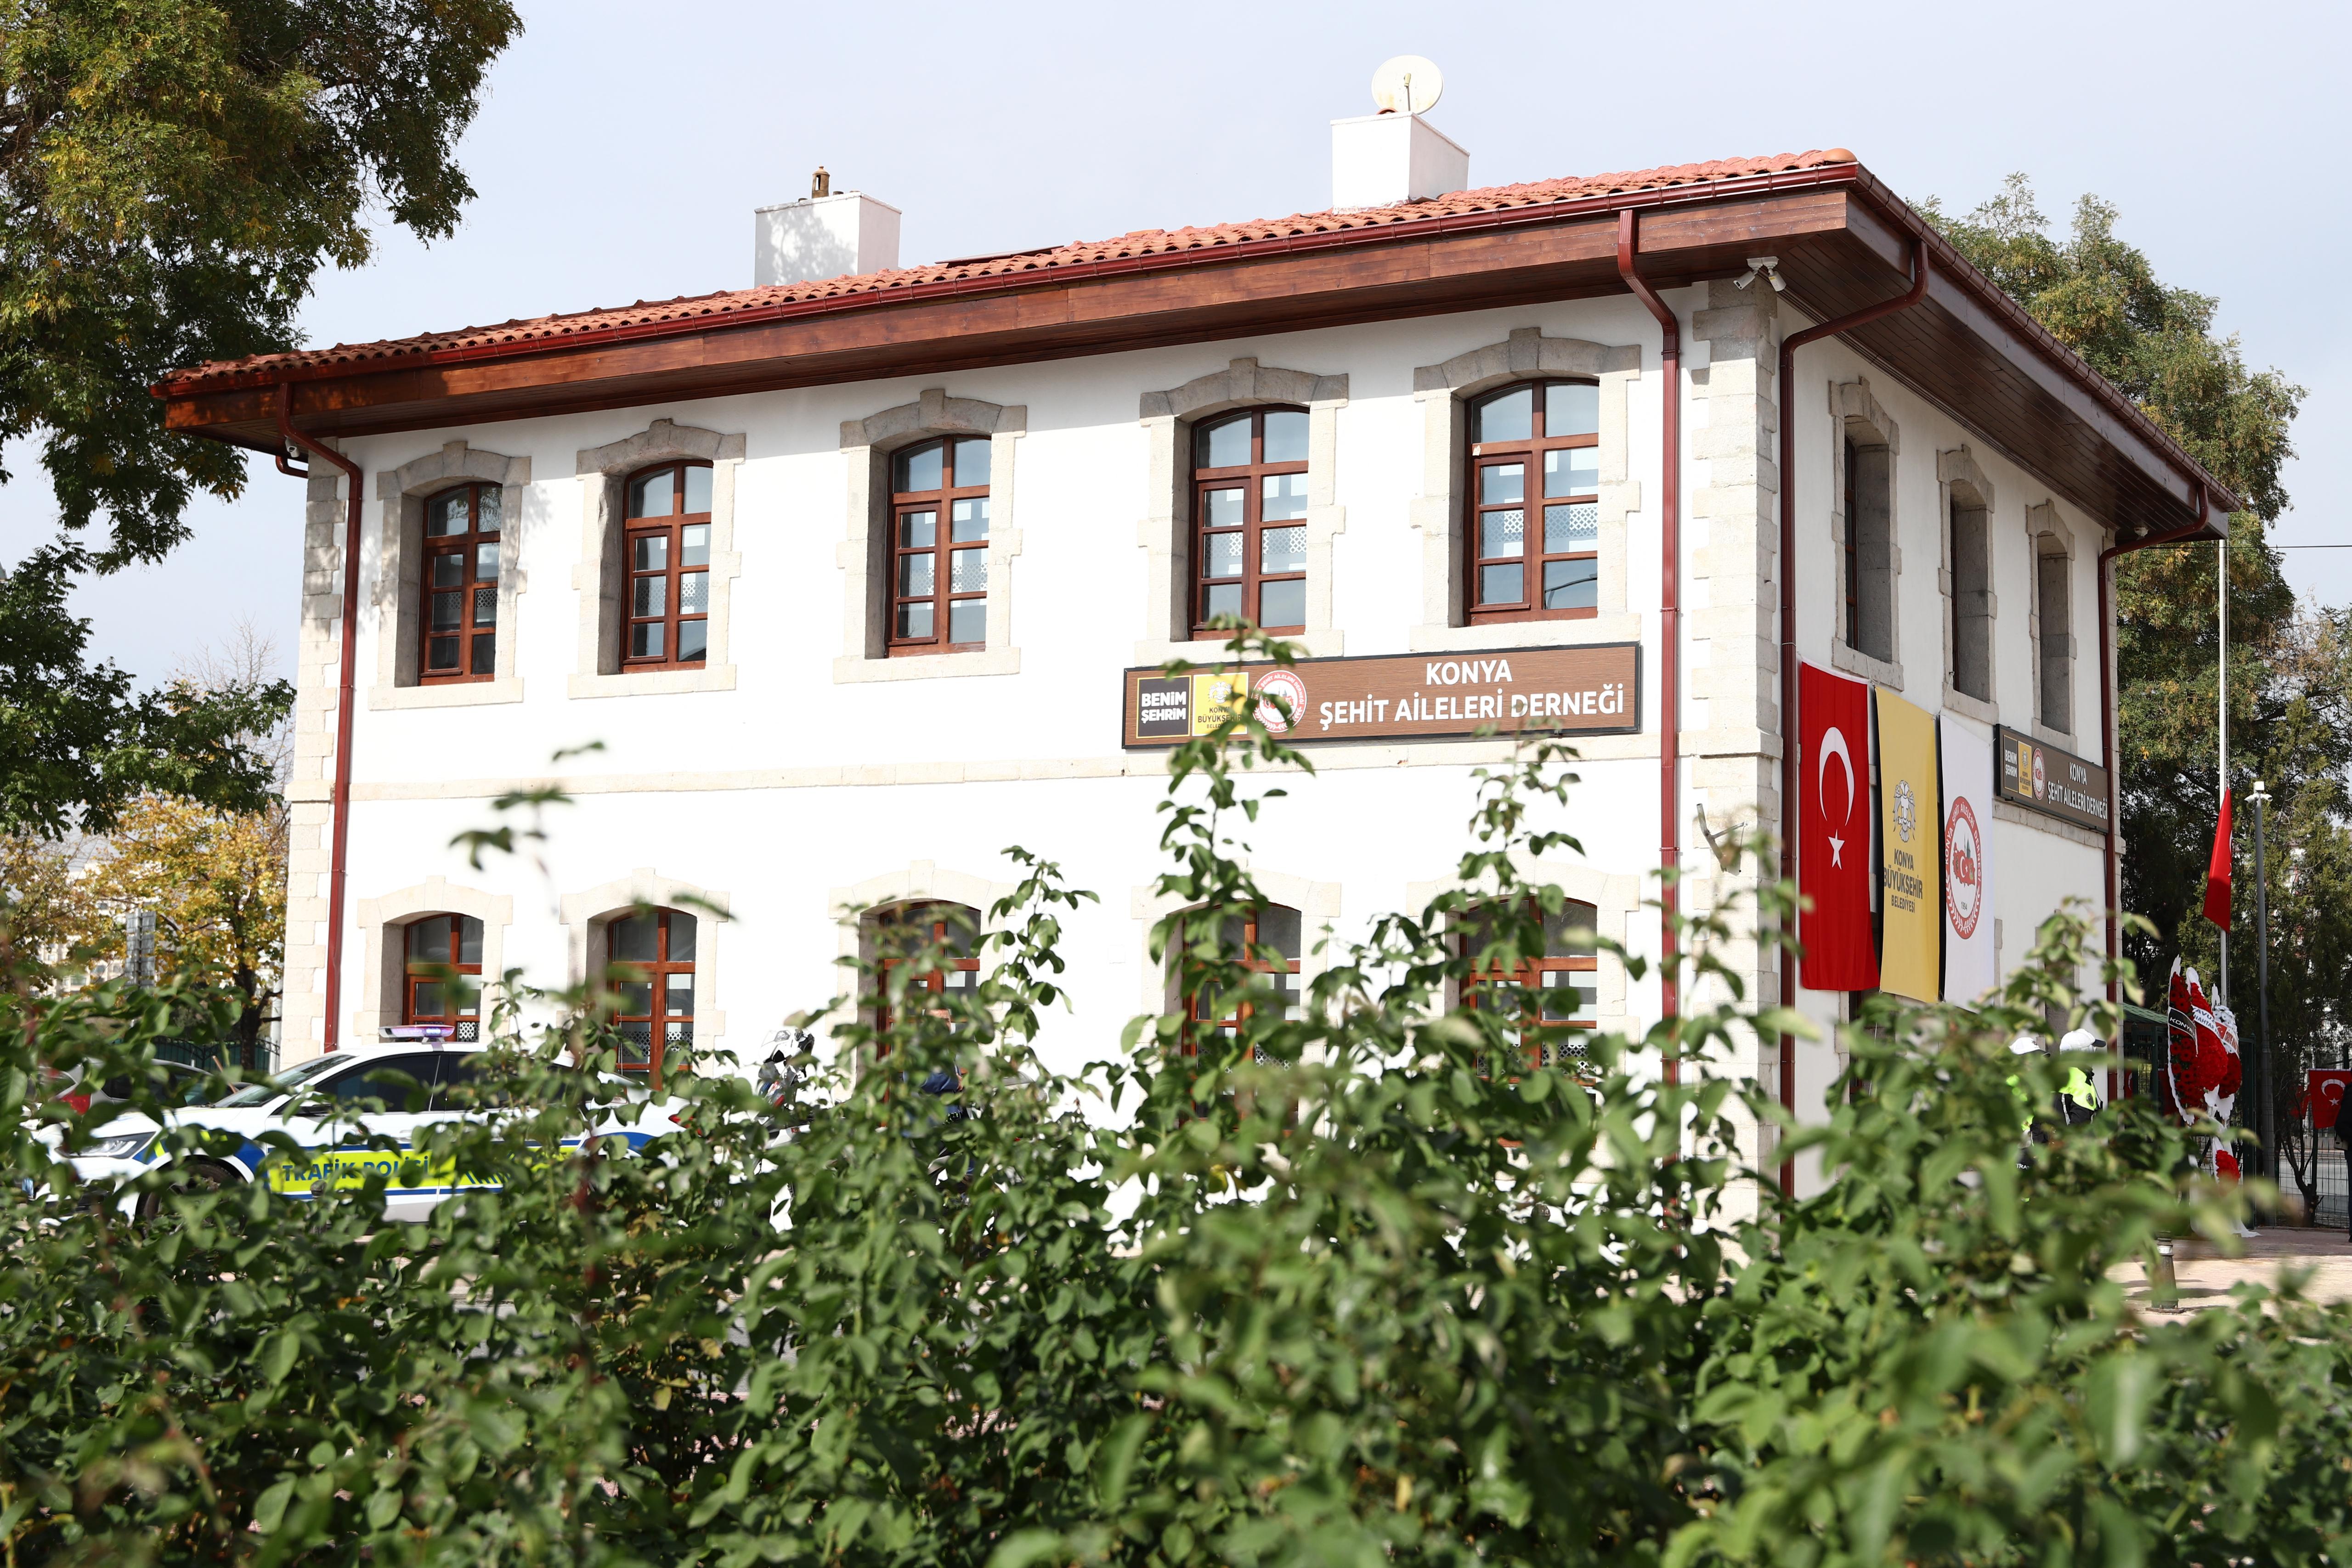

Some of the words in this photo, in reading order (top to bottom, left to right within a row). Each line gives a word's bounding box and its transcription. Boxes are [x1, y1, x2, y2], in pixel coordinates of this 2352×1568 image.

[1426, 660, 1513, 685] KONYA
[1141, 691, 1187, 707] BENİM
[1261, 675, 1273, 688] ŞEHİT
[1274, 673, 1295, 683] AİLELERİ
[1294, 682, 1304, 705] DERNEĞİ
[1141, 708, 1187, 724] ŞEHRİM
[1319, 694, 1389, 731] ŞEHİT
[1394, 688, 1503, 722] AİLELERİ
[1511, 683, 1623, 717] DERNEĞİ
[2005, 750, 2017, 765] BENİM
[2069, 762, 2087, 785] KONYA
[2048, 779, 2063, 804] ŞEHİT
[2064, 783, 2086, 812] AİLELERİ
[2086, 796, 2107, 820] DERNEĞİ
[1961, 802, 1974, 829] AİLELERİ
[1894, 848, 1914, 871] KONYA
[1884, 864, 1923, 899] BÜYÜKŞEHİR
[1891, 895, 1915, 914] BELEDİYESİ
